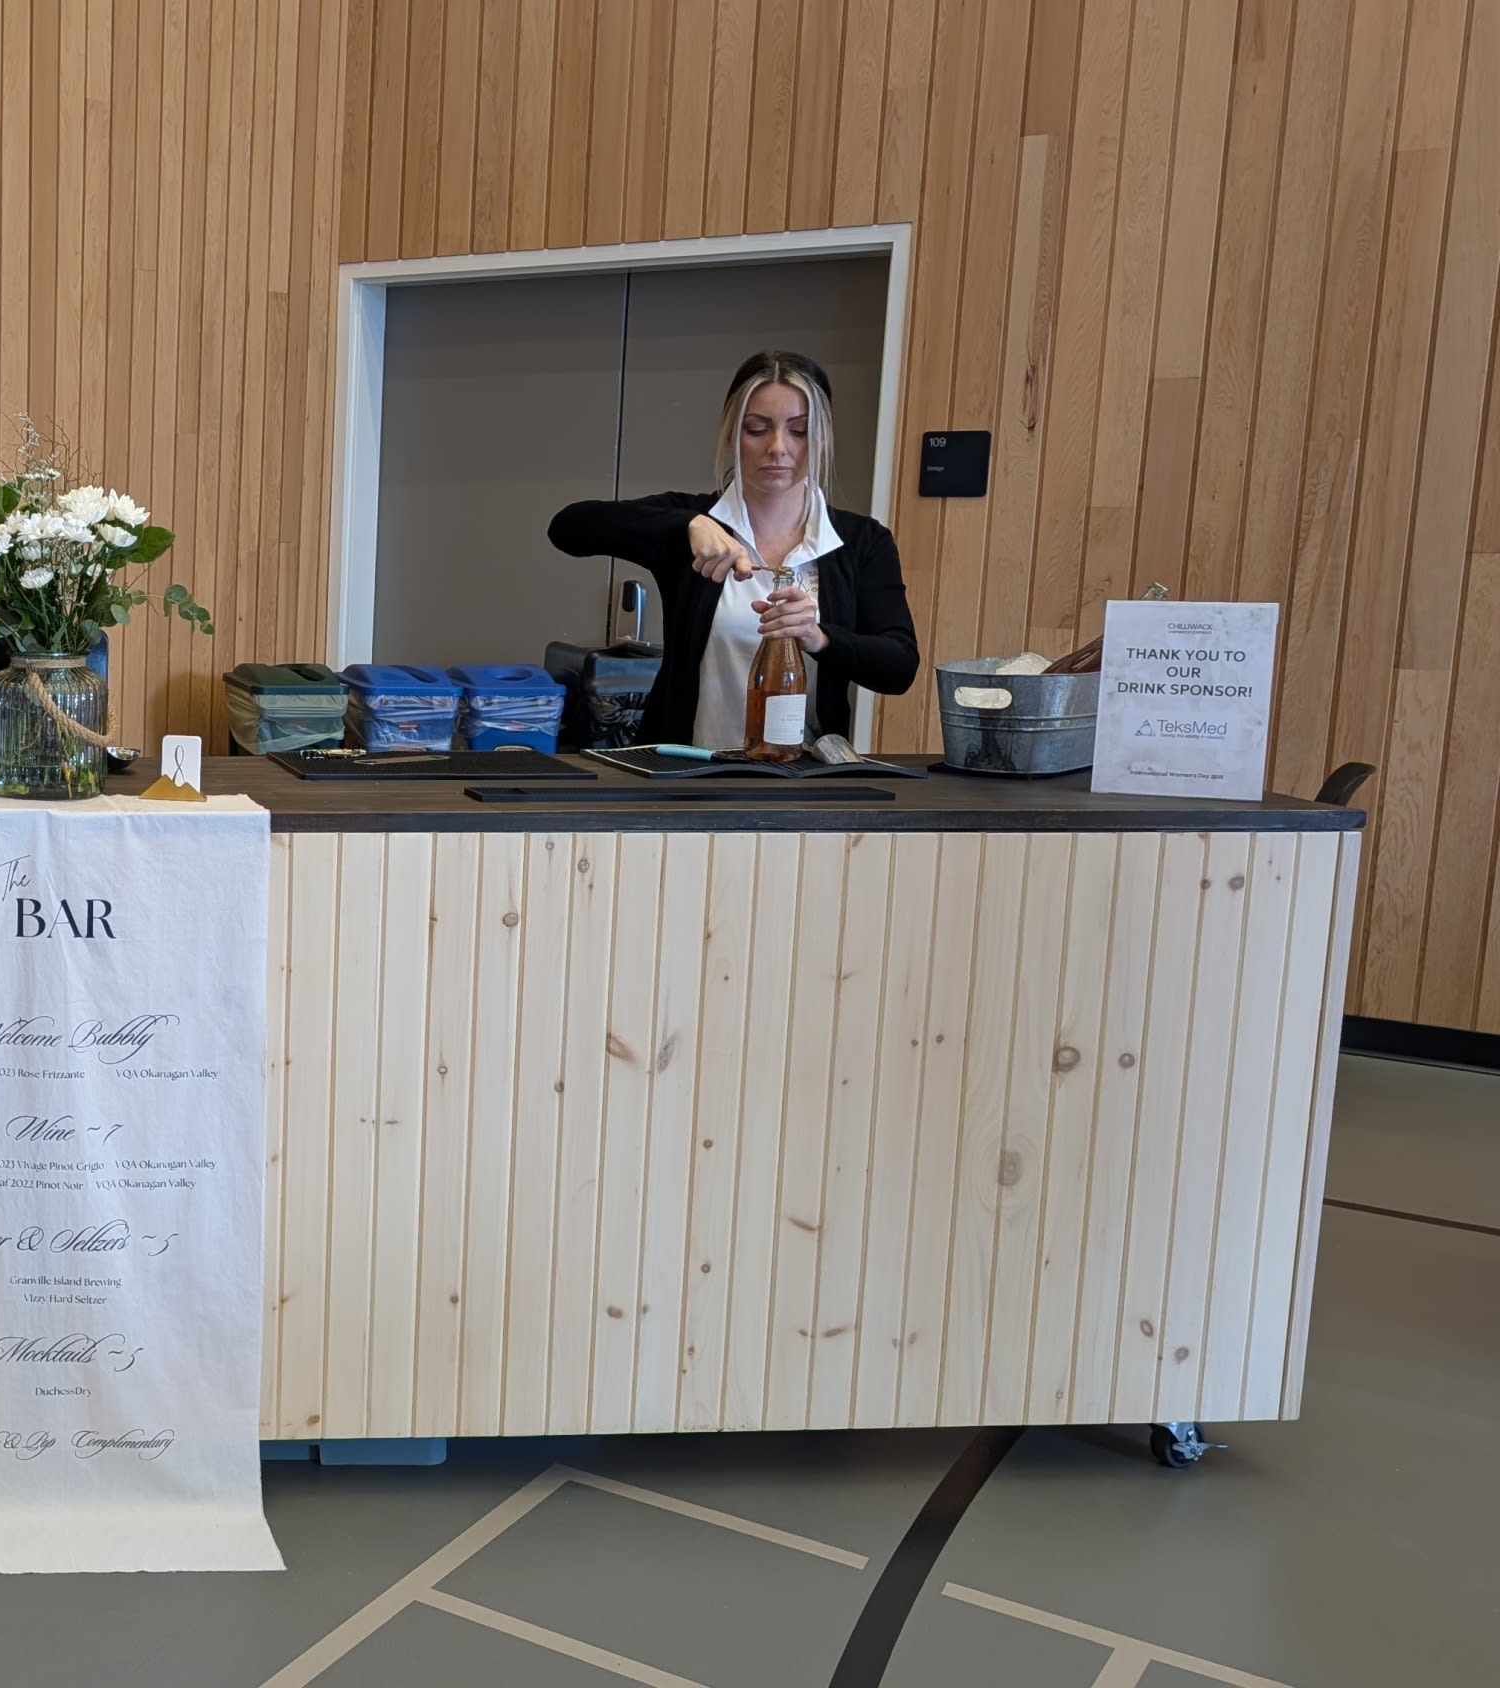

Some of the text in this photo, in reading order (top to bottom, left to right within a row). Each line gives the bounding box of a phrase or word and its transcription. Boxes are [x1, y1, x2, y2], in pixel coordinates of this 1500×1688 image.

[929, 437, 947, 448] 109
[1126, 648, 1246, 662] THANK YOU TO
[1166, 666, 1201, 678] OUR
[1117, 682, 1253, 697] DRINK SPONSOR!
[1157, 719, 1227, 735] TeksMed
[15, 898, 116, 939] BAR
[68, 1014, 180, 1064] Bubbly
[18, 1069, 40, 1078] Rose
[42, 1069, 86, 1079] Frizzante
[116, 1069, 138, 1079] VQA
[140, 1069, 188, 1080] Okanagan
[191, 1069, 218, 1079] Valley
[6, 1115, 76, 1142] Wine
[103, 1124, 123, 1144] 7
[49, 1162, 73, 1171] Pinot
[76, 1162, 104, 1173] Grigio
[115, 1161, 137, 1170] VQA
[139, 1160, 186, 1170] Okanagan
[189, 1160, 216, 1169] Valley
[11, 1179, 33, 1188] 2022
[36, 1180, 60, 1189] Pinot
[63, 1182, 84, 1190] Noir
[96, 1181, 116, 1190] VQA
[118, 1179, 167, 1190] Okanagan
[169, 1178, 196, 1189] Valley
[17, 1226, 44, 1251] &
[50, 1219, 131, 1253] Seltzers
[148, 1233, 179, 1256] 5
[10, 1276, 122, 1288] Granville Island Brewing
[24, 1294, 108, 1304] Vizzy Hard Seltzer
[114, 1348, 144, 1372] 5
[4, 1433, 21, 1449] &
[16, 1431, 56, 1460] Pop
[72, 1429, 174, 1461] Complimentary
